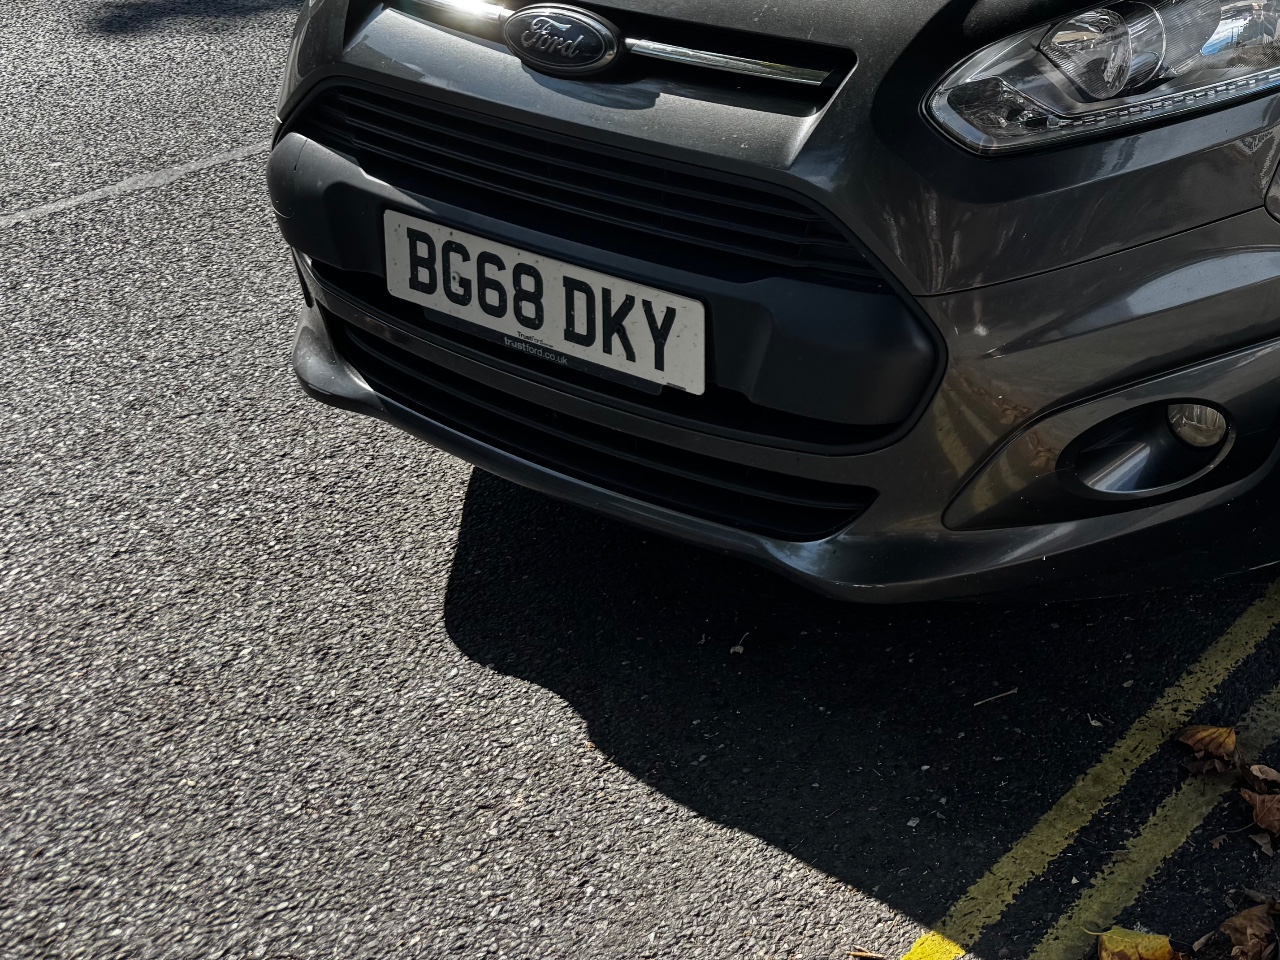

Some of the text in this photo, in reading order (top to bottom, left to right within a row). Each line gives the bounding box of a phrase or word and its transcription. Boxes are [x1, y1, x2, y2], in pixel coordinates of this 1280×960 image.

[520, 16, 585, 58] Ford
[406, 227, 677, 372] BG68 DKY
[503, 336, 568, 365] trustford.co.uk
